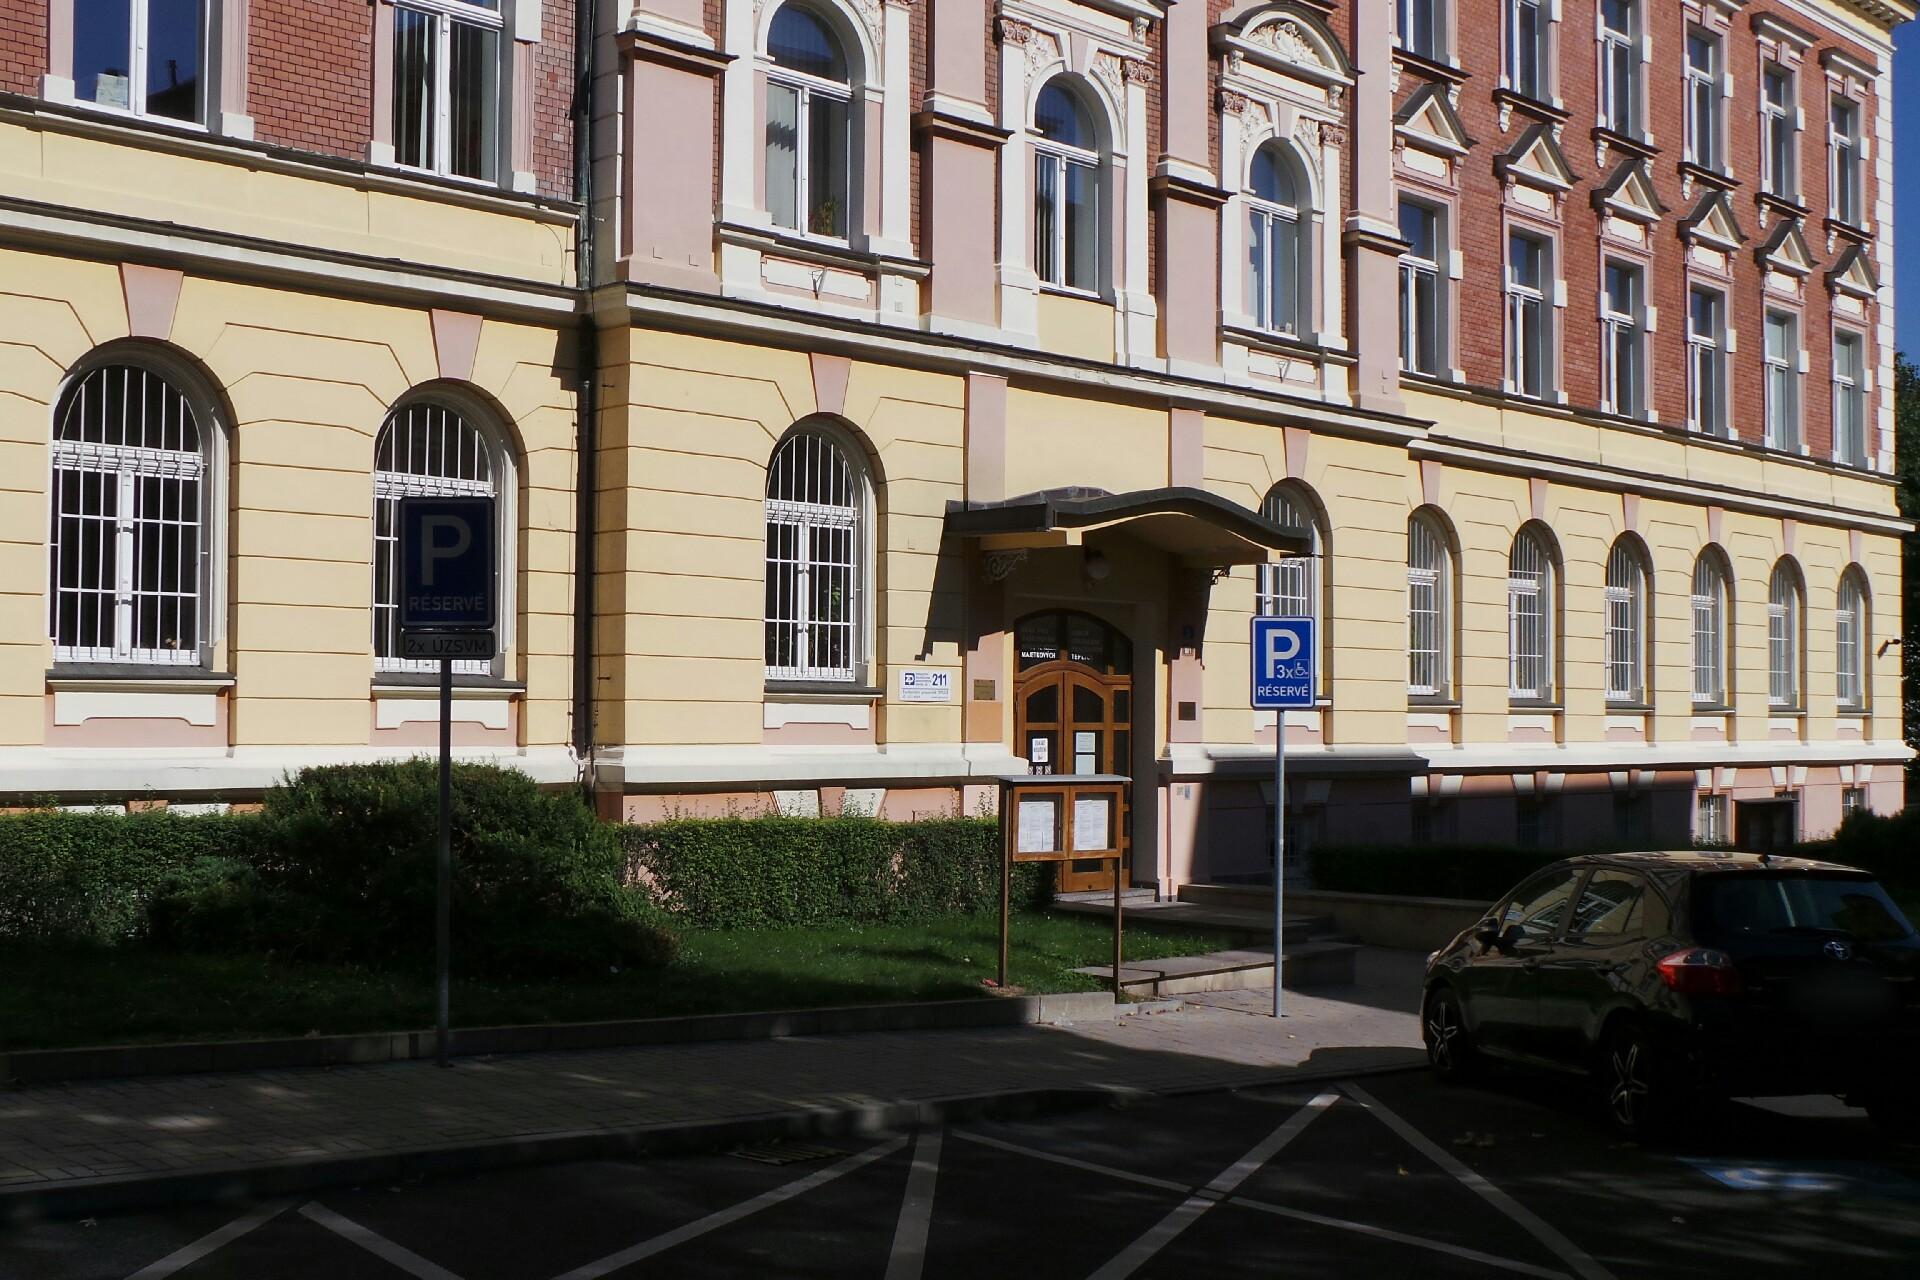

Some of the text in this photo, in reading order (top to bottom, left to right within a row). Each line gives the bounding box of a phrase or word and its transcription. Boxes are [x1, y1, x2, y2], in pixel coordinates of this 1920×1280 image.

[421, 514, 472, 586] P
[408, 593, 485, 611] RÉSERVÉ
[408, 635, 488, 653] 2x ÚZSVM
[1266, 628, 1300, 678] P
[932, 673, 947, 686] 211
[1276, 664, 1294, 679] 3x
[1257, 683, 1309, 696] RÉSERVÉ
